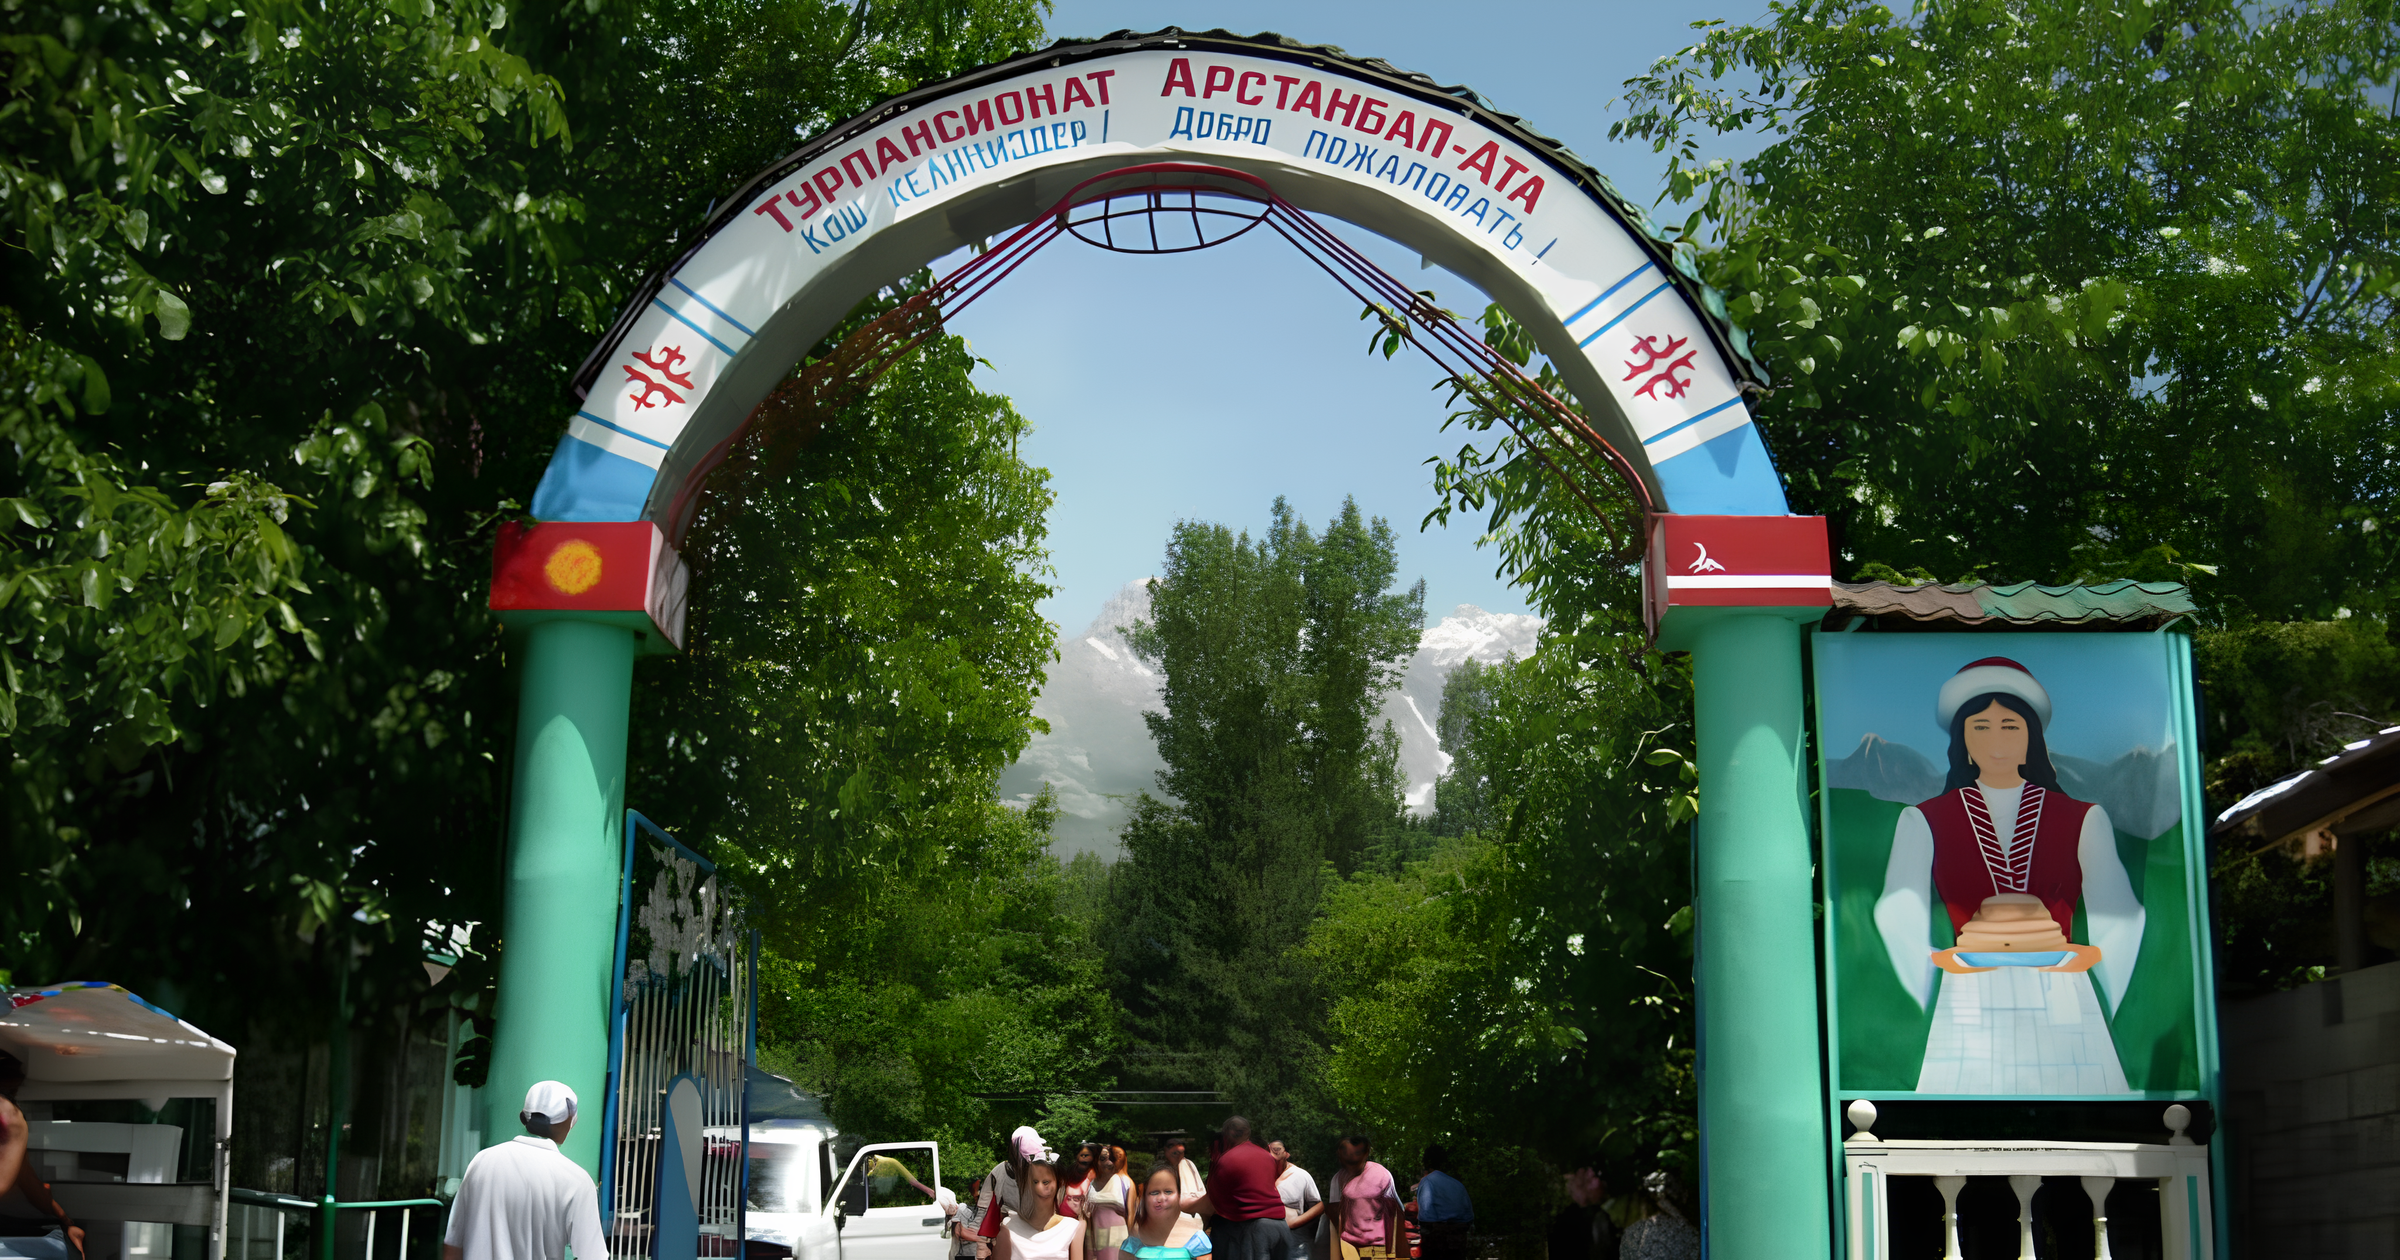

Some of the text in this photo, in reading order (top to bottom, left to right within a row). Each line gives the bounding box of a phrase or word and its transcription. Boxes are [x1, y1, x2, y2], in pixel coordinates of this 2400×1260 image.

[754, 58, 1545, 232] ТУРПАНСИОНАТ АРСТАНБАП-АТА
[801, 201, 867, 254] КОШ
[1169, 106, 1272, 145] ДОБРО
[1303, 130, 1523, 250] ПОЖАЛОВАТЬ
